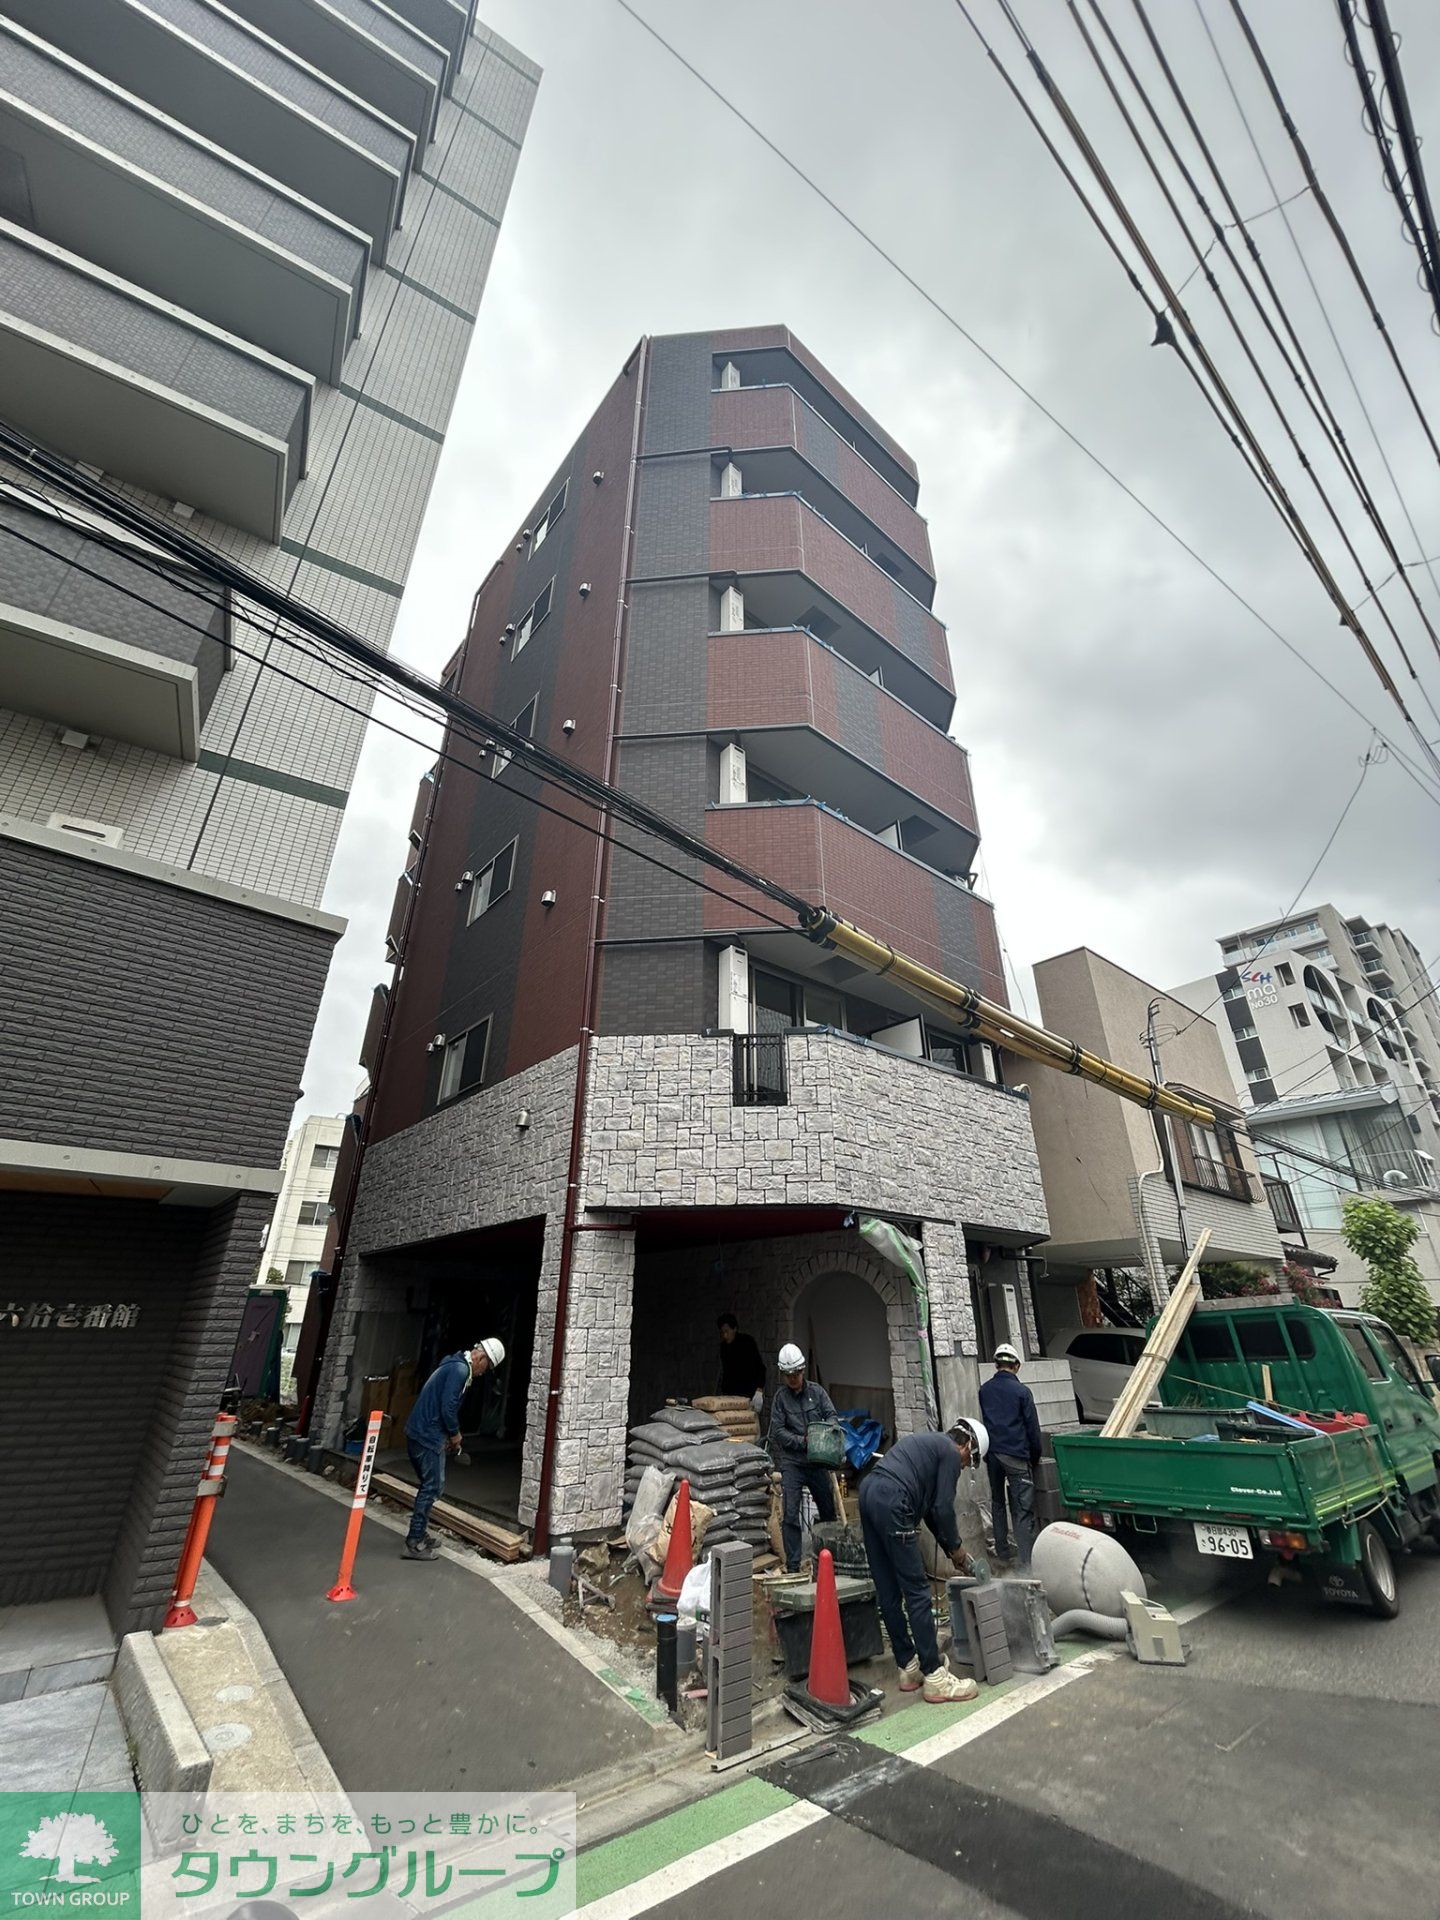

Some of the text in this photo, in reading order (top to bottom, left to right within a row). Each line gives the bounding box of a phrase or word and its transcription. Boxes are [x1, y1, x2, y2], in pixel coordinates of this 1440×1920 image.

[1247, 984, 1276, 1000] ma
[1207, 1535, 1249, 1556] 96-05
[1323, 1586, 1359, 1600] TOYOTA
